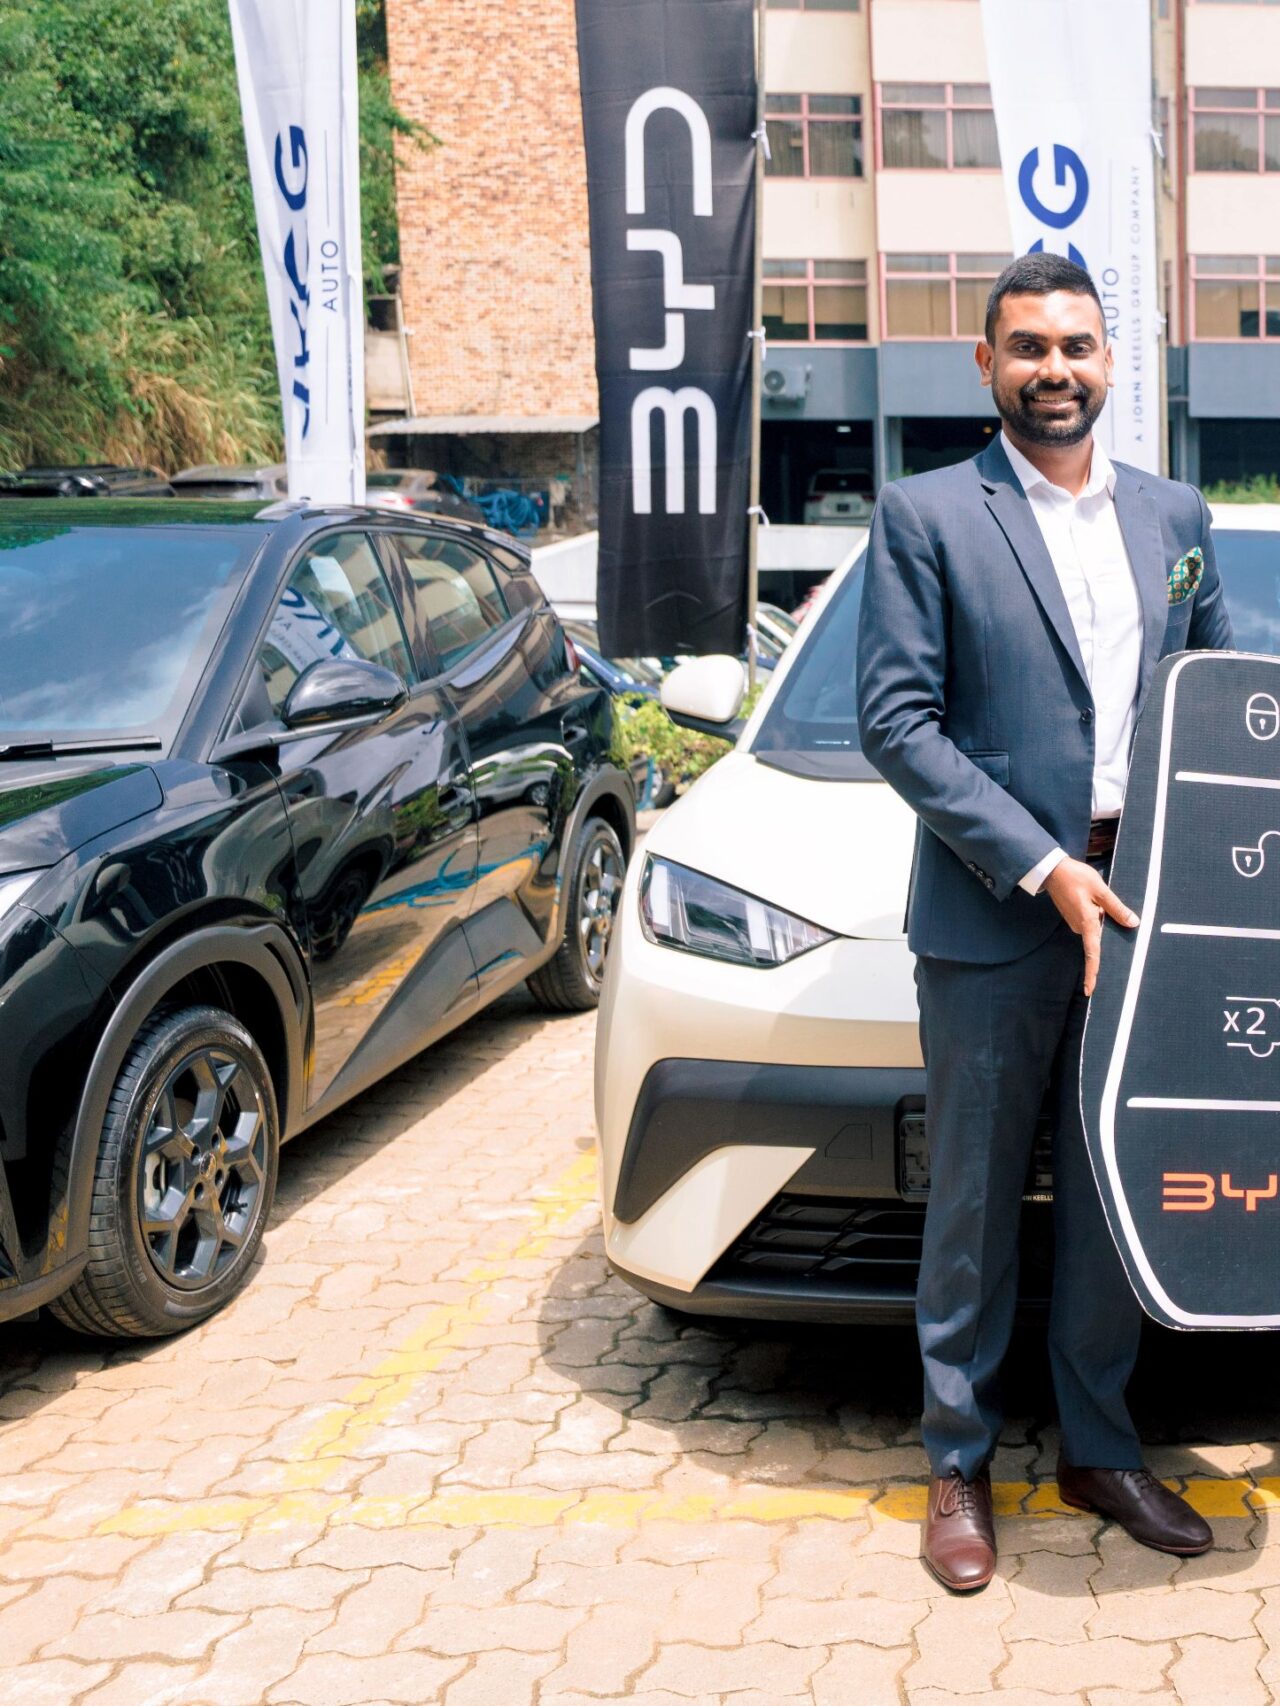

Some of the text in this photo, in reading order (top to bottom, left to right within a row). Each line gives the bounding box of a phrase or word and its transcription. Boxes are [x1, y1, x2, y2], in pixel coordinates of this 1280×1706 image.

[320, 239, 339, 312] AUTO
[625, 87, 717, 515] BYD
[1102, 267, 1120, 340] AUTO
[1130, 165, 1143, 443] A JOHN KEELLS GROUP COMPANY
[1223, 1007, 1266, 1035] x2
